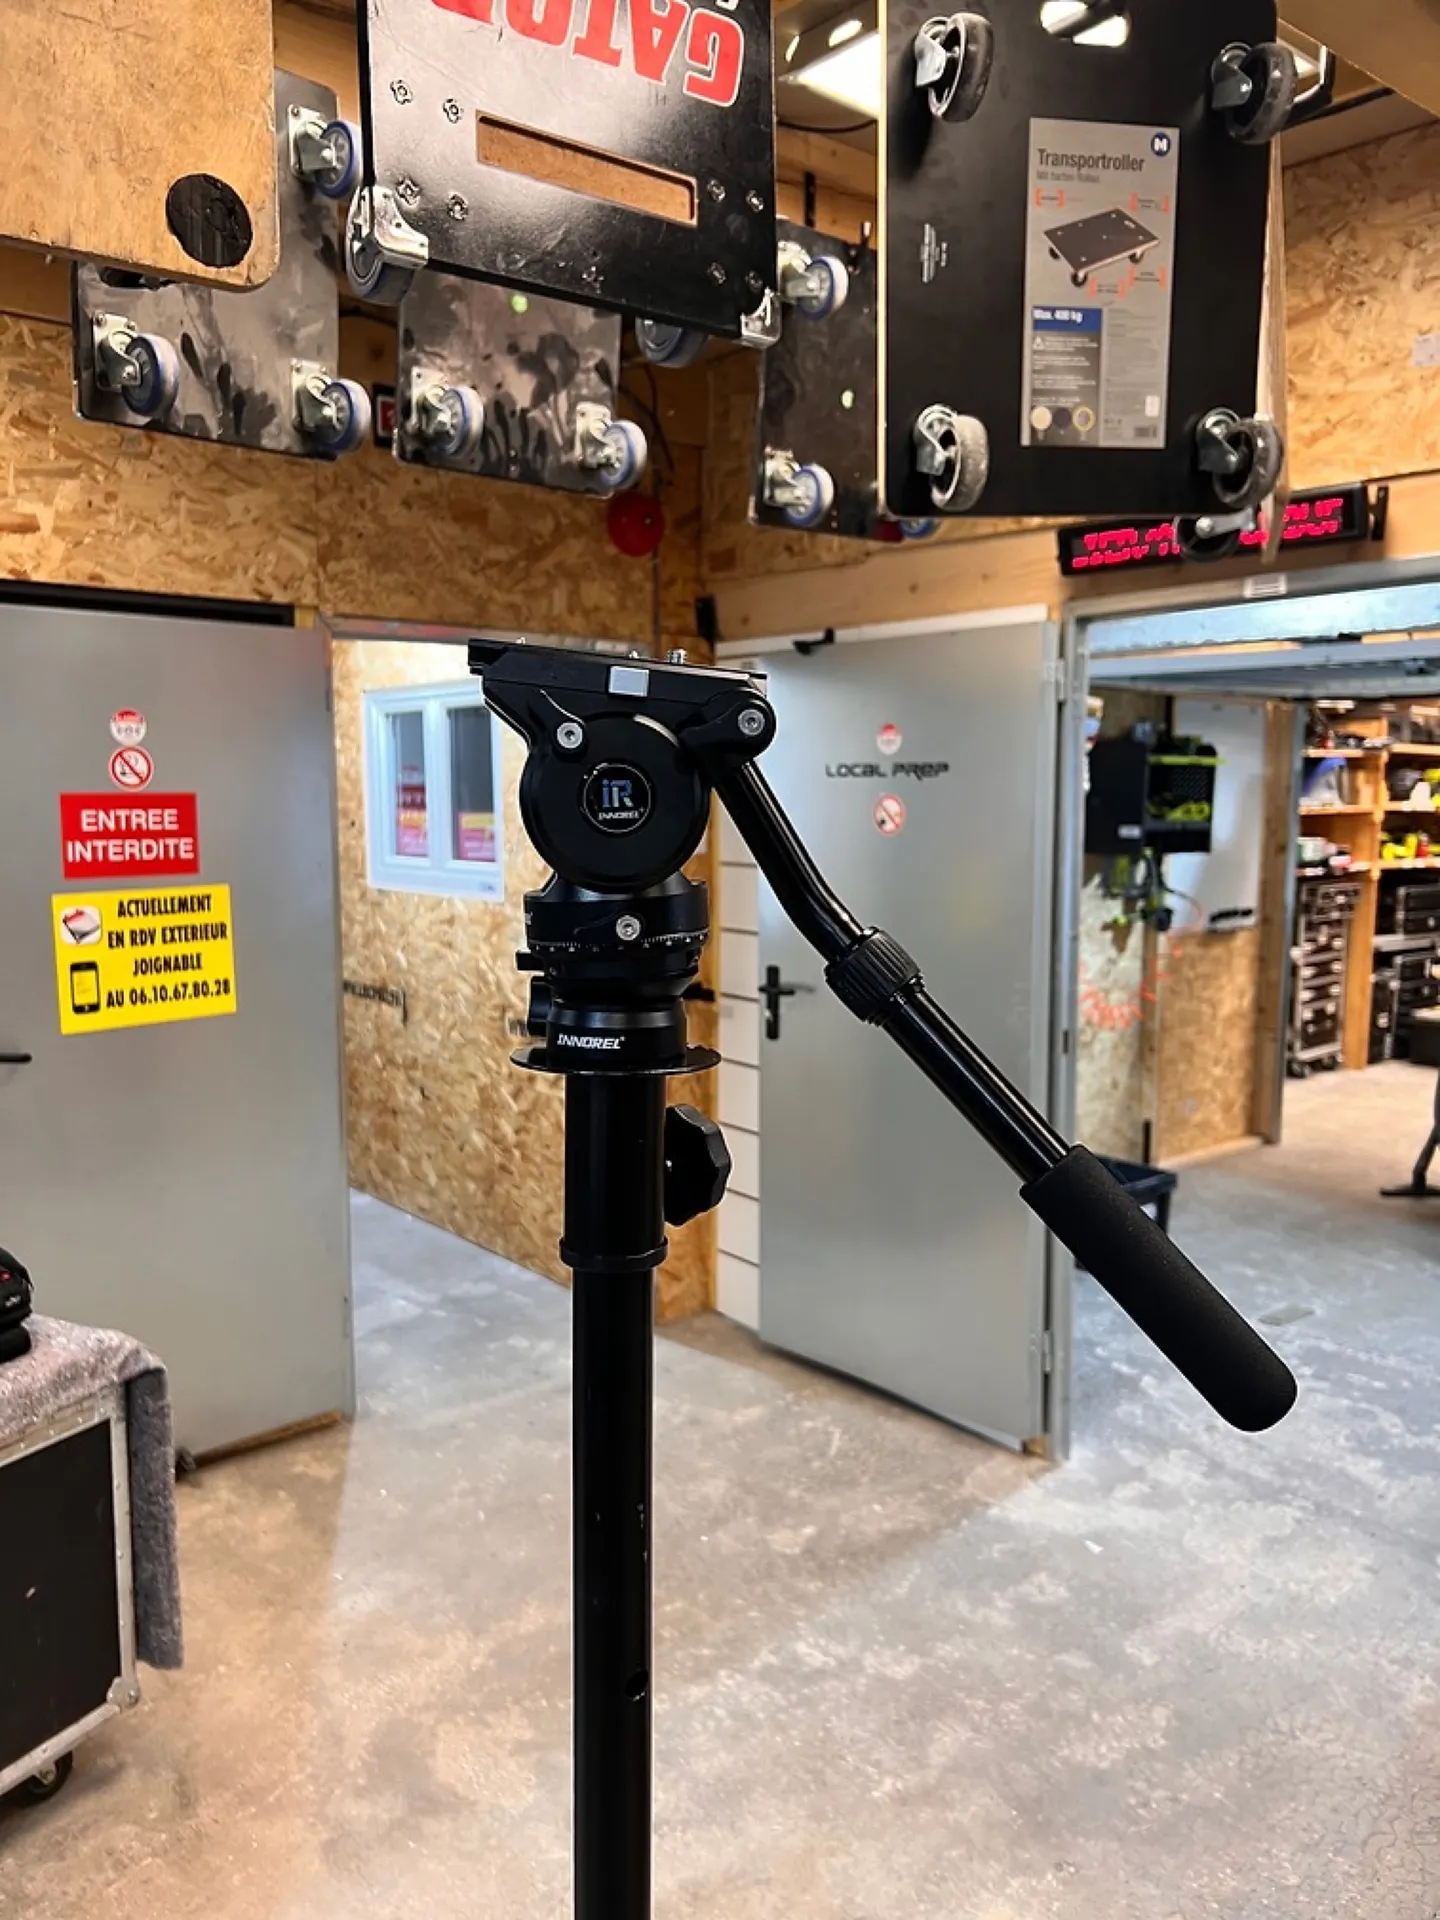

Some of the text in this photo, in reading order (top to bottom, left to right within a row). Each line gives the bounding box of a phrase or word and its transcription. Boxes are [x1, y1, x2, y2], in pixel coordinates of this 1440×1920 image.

[1037, 148, 1145, 172] Transportroller
[825, 761, 950, 781] LOCAL PREP
[80, 808, 180, 832] ENTREE
[67, 837, 195, 863] INTERDITE
[117, 894, 211, 918] ACTUELLEMENT
[107, 922, 227, 950] EN RDV EXTERIEUR
[133, 953, 202, 976] JOIGNABLE
[106, 978, 230, 1010] AU 06.10.67.80.28
[557, 1033, 622, 1050] INNOREL
